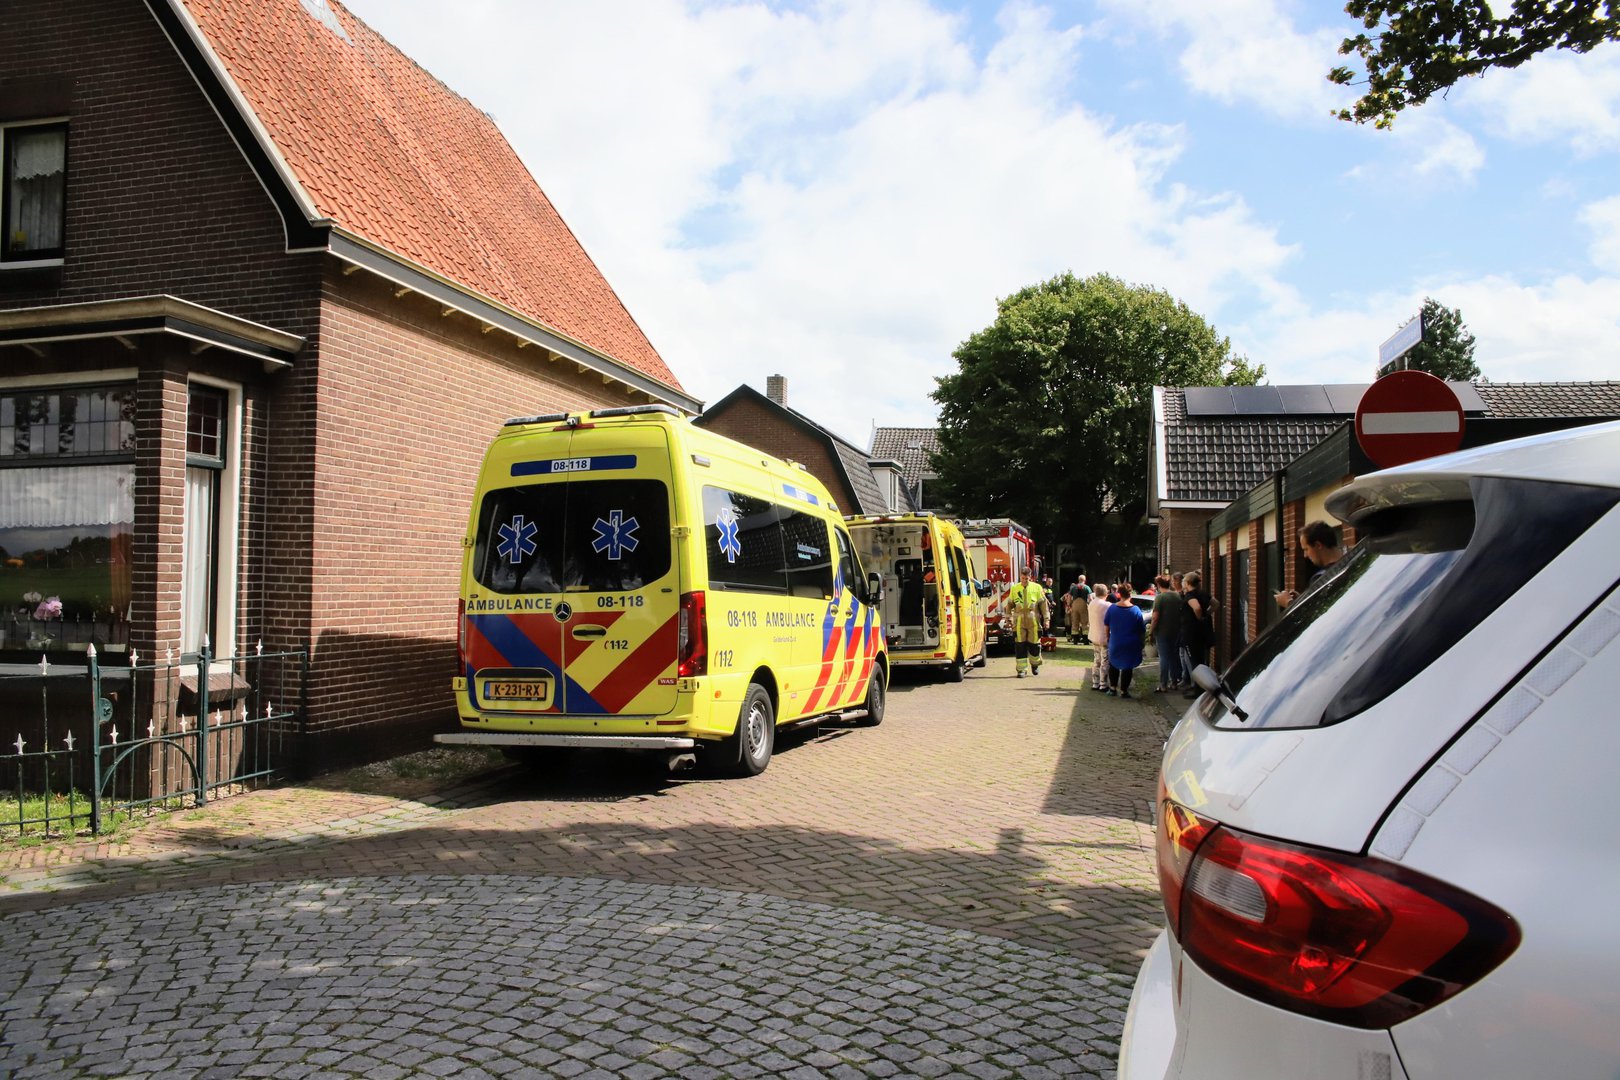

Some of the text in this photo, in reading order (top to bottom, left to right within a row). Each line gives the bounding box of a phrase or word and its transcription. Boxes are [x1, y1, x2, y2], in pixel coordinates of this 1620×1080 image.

[553, 460, 588, 470] 08-118
[467, 598, 553, 611] AMBULANCE
[597, 595, 644, 608] 08-118
[727, 610, 815, 627] 08-118 AMBULANCE
[494, 684, 540, 696] K-231-RX
